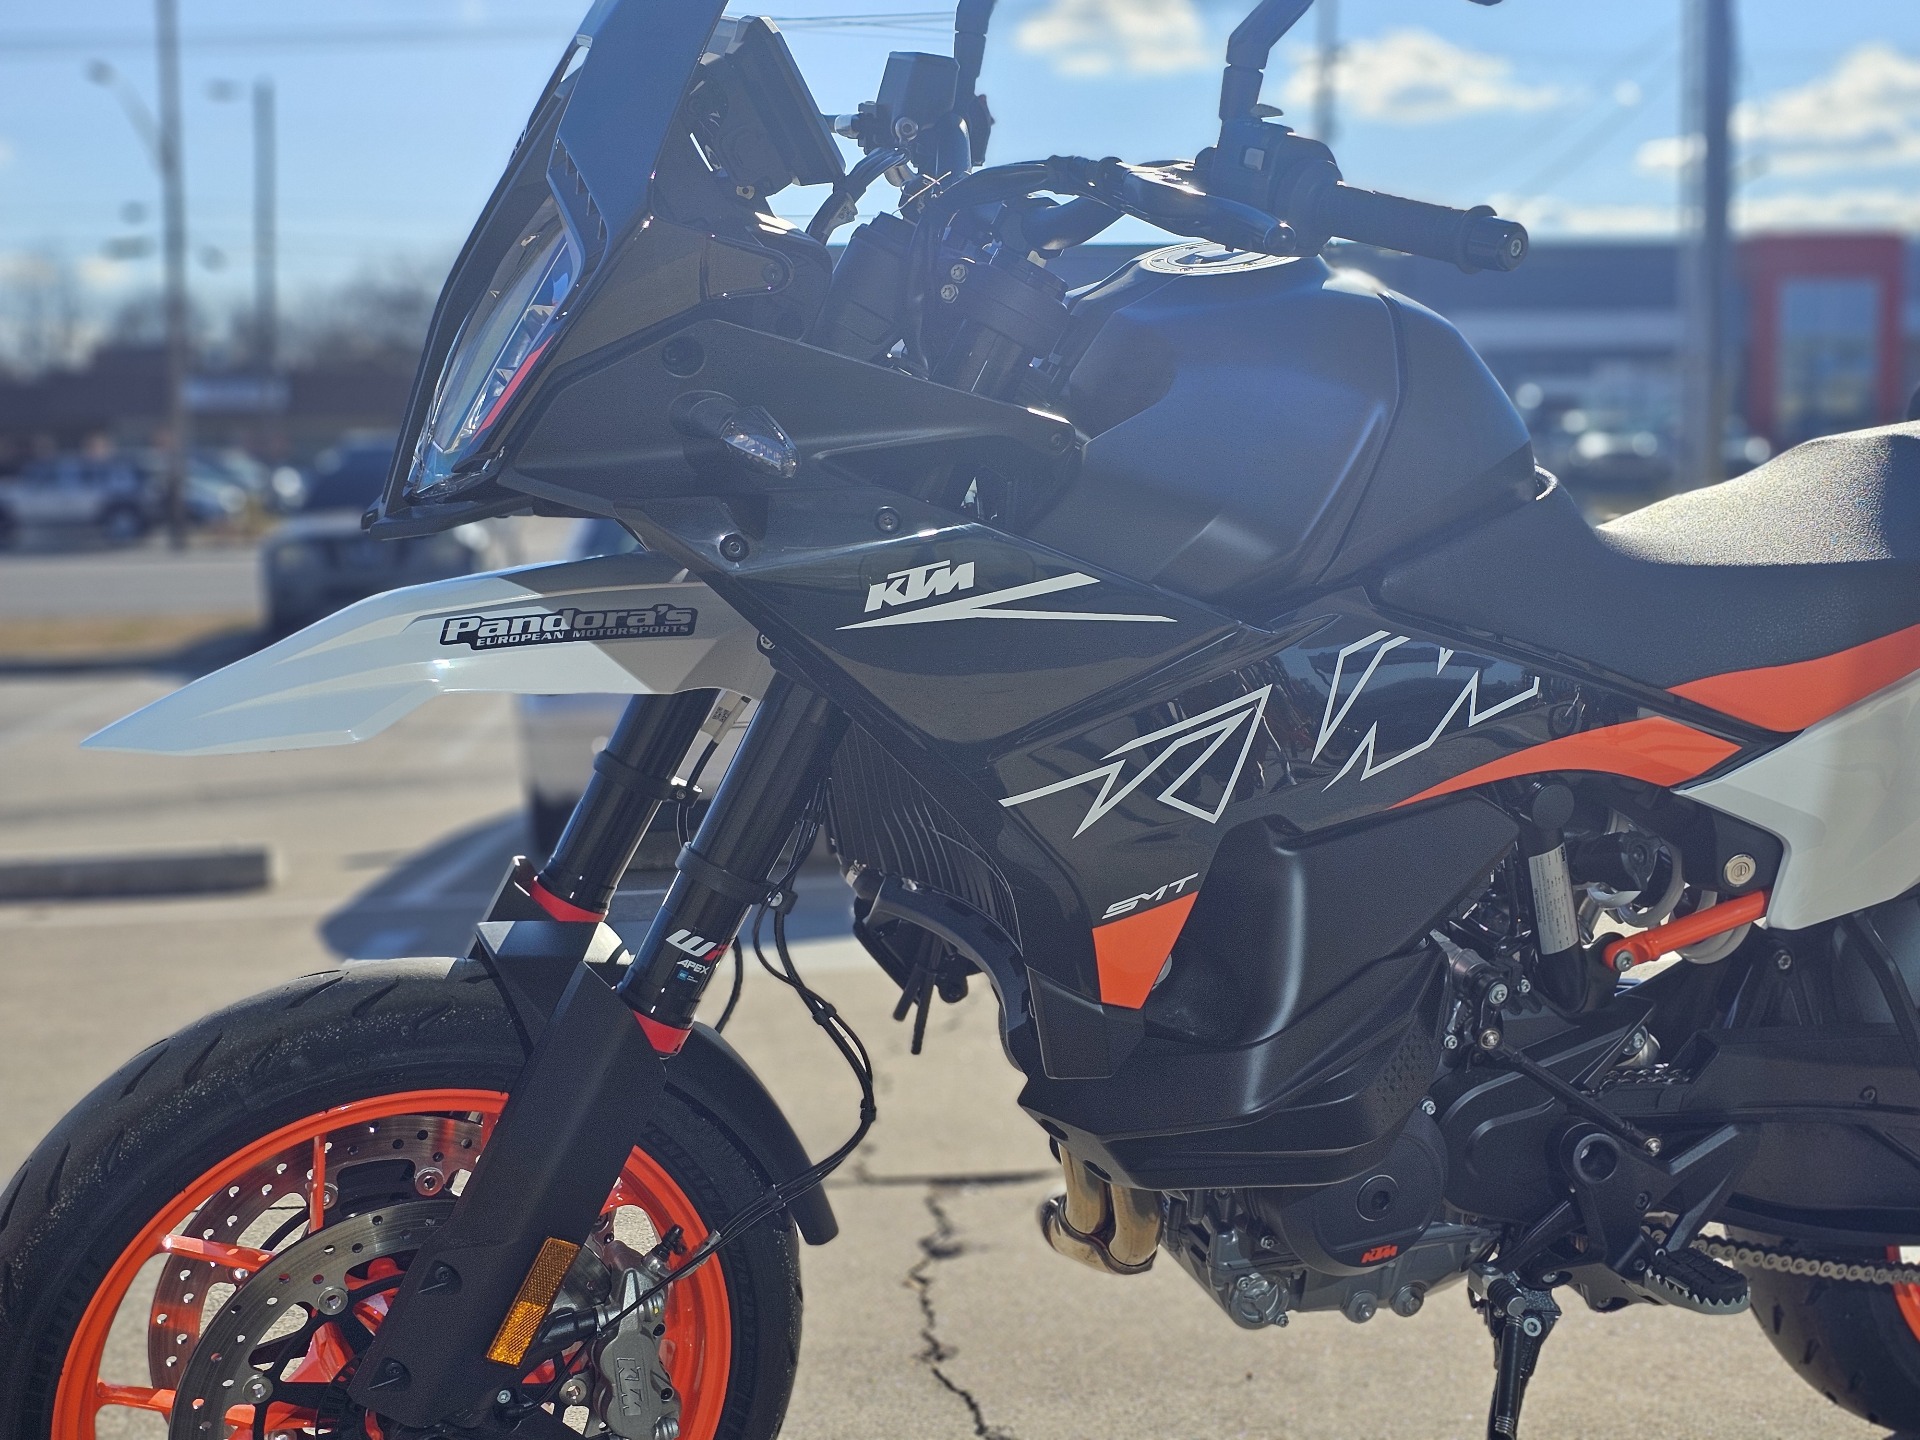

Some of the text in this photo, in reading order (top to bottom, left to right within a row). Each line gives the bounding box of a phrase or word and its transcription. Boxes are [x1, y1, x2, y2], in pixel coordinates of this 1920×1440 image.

[864, 560, 975, 613] KTM
[444, 605, 692, 642] Pandora's
[476, 624, 690, 647] EUROPEAN MOTORSPORTS
[1101, 872, 1199, 919] SMT
[676, 959, 710, 975] APEX
[1361, 1244, 1398, 1264] KTM
[616, 1357, 643, 1417] KTM
